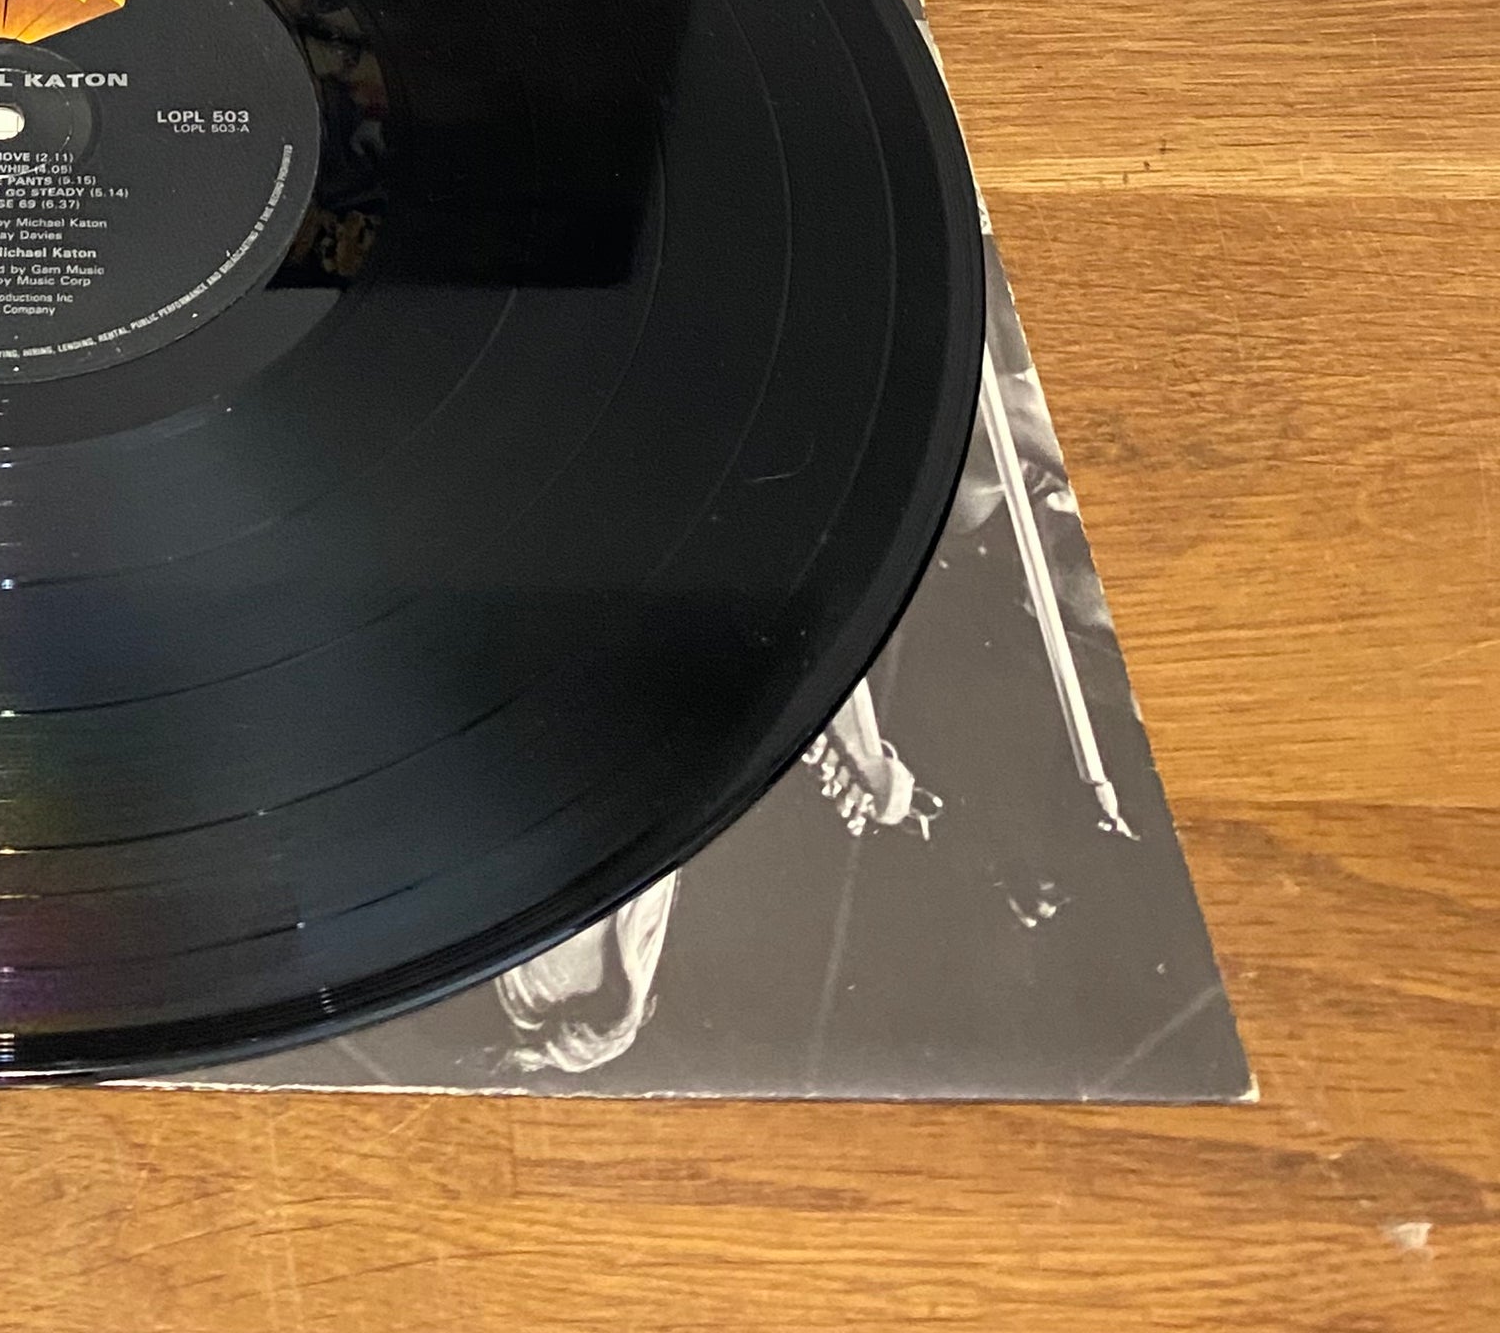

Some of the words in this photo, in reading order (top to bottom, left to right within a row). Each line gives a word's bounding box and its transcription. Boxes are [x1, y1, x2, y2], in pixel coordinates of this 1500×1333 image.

[24, 73, 128, 87] KATON
[157, 110, 205, 123] LOPL
[212, 110, 249, 123] 503
[173, 124, 205, 133] LOPL
[35, 152, 74, 163] (2.11)
[7, 176, 53, 185] PANTS
[5, 188, 25, 197] GO
[30, 187, 85, 197] STEADY
[19, 199, 37, 209] 69
[16, 218, 65, 227] Michael
[70, 218, 108, 228] Katon
[20, 230, 63, 240] Davies
[53, 247, 97, 258] Katon
[11, 265, 26, 275] by
[66, 265, 104, 275] Music
[17, 276, 55, 286] Music
[60, 276, 91, 287] Corp
[56, 293, 74, 303] Inc
[3, 305, 55, 316] Company
